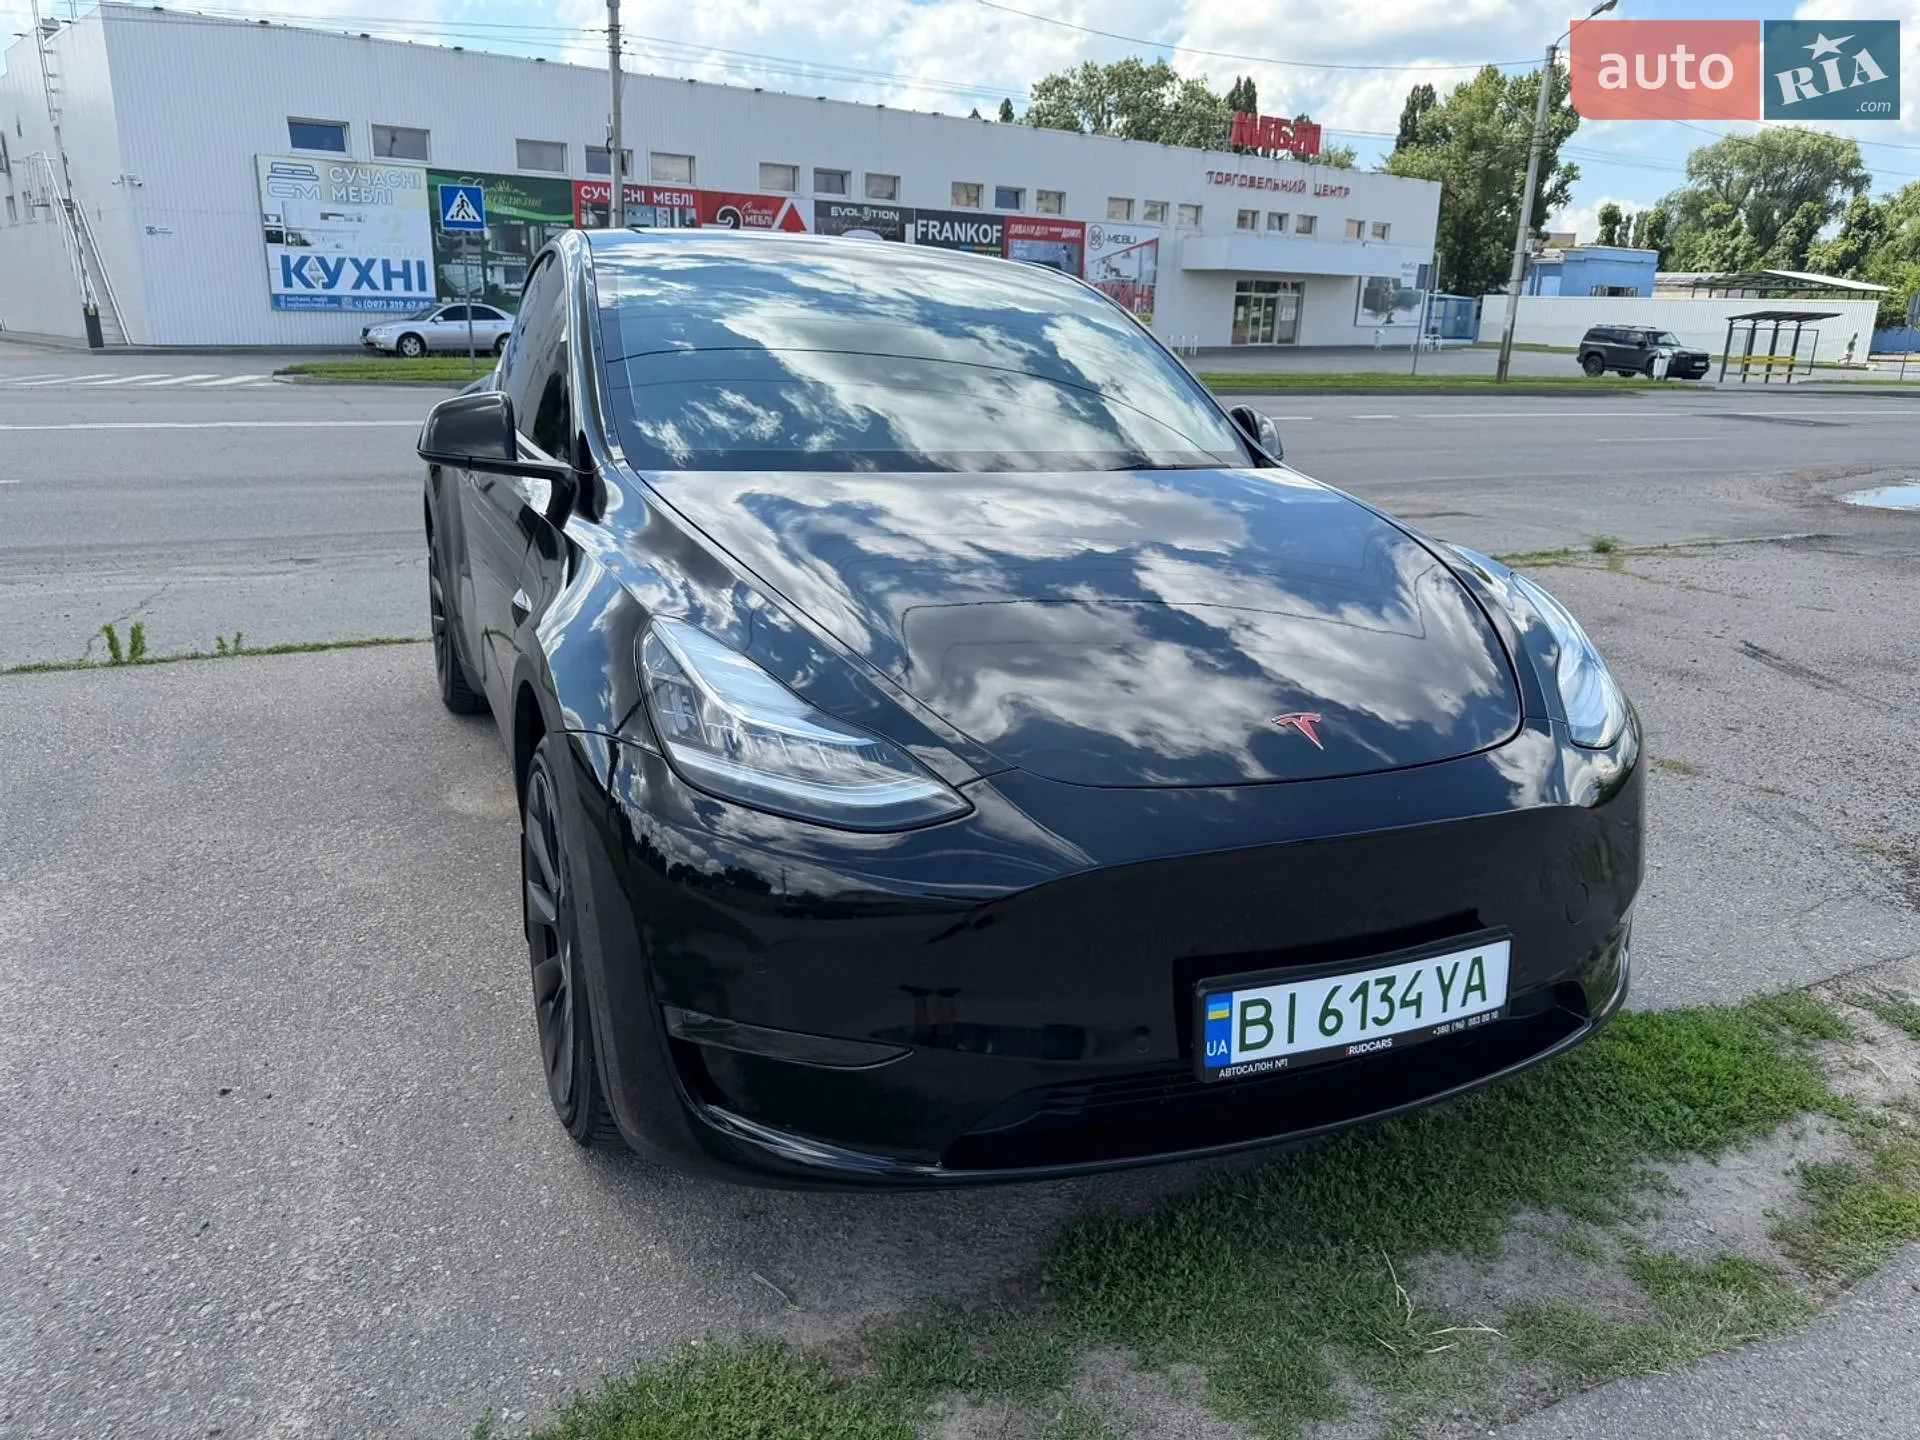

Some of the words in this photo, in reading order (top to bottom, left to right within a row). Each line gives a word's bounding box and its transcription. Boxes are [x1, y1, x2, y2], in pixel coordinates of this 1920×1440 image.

[328, 166, 422, 191] СУЧАСНІ
[1206, 171, 1307, 195] ТОРГОВЕЛЬНИЙ
[1314, 183, 1351, 198] ЦЕНТР
[331, 184, 395, 206] МЕБЛІ
[653, 191, 694, 207] МЕБЛІ
[279, 254, 428, 293] КУХНІ
[1239, 992, 1297, 1052] BI
[1318, 969, 1424, 1037] 6134
[1435, 955, 1488, 1013] YA
[1206, 1039, 1229, 1057] UA
[1347, 1037, 1393, 1056] RUDCARS
[1218, 1061, 1274, 1079] АВТОСАЛОН
[1274, 1058, 1289, 1069] №1
